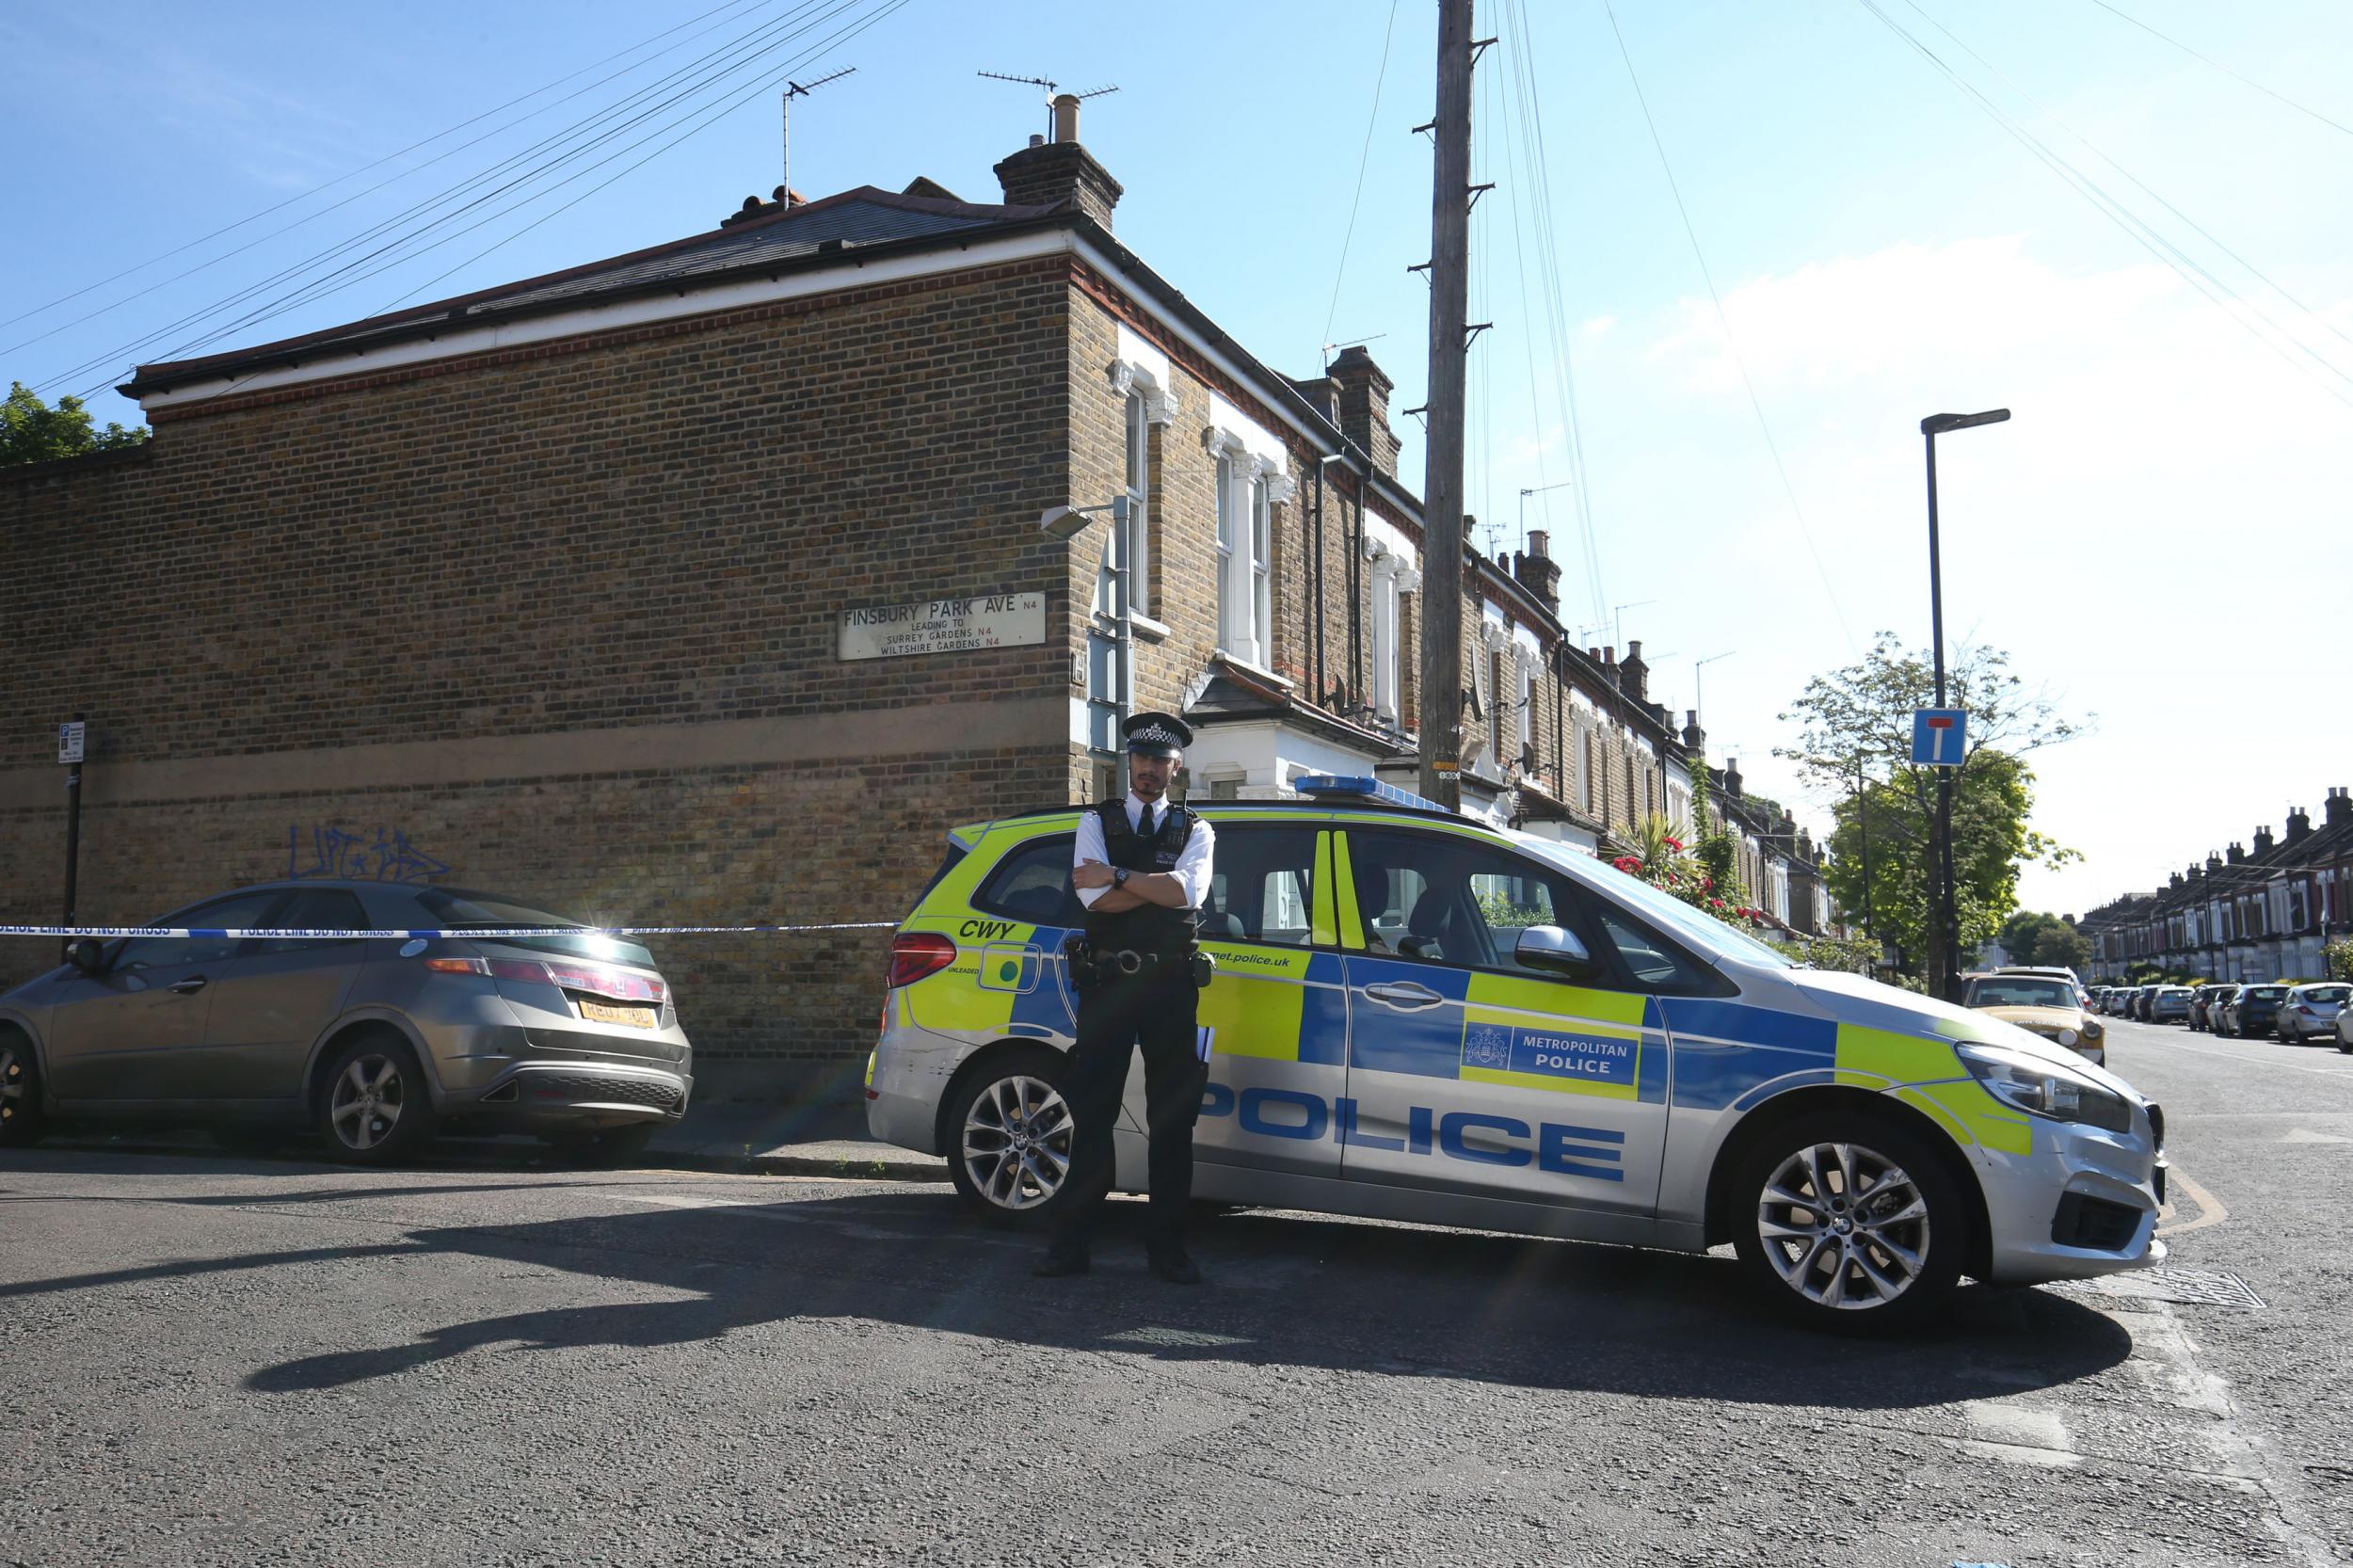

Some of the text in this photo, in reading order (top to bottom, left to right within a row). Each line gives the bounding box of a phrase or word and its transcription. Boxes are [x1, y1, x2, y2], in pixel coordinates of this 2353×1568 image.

[844, 596, 1037, 627] FINSBURY PARK AVE N4
[911, 618, 964, 632] LEADING TO
[887, 627, 992, 645] SURREY GARDENS N4
[881, 637, 1000, 655] WILTSHIRE GARDENS N4
[959, 920, 1016, 940] CWY
[1523, 1036, 1627, 1057] METROPOLITAN
[1535, 1054, 1610, 1073] POLICE
